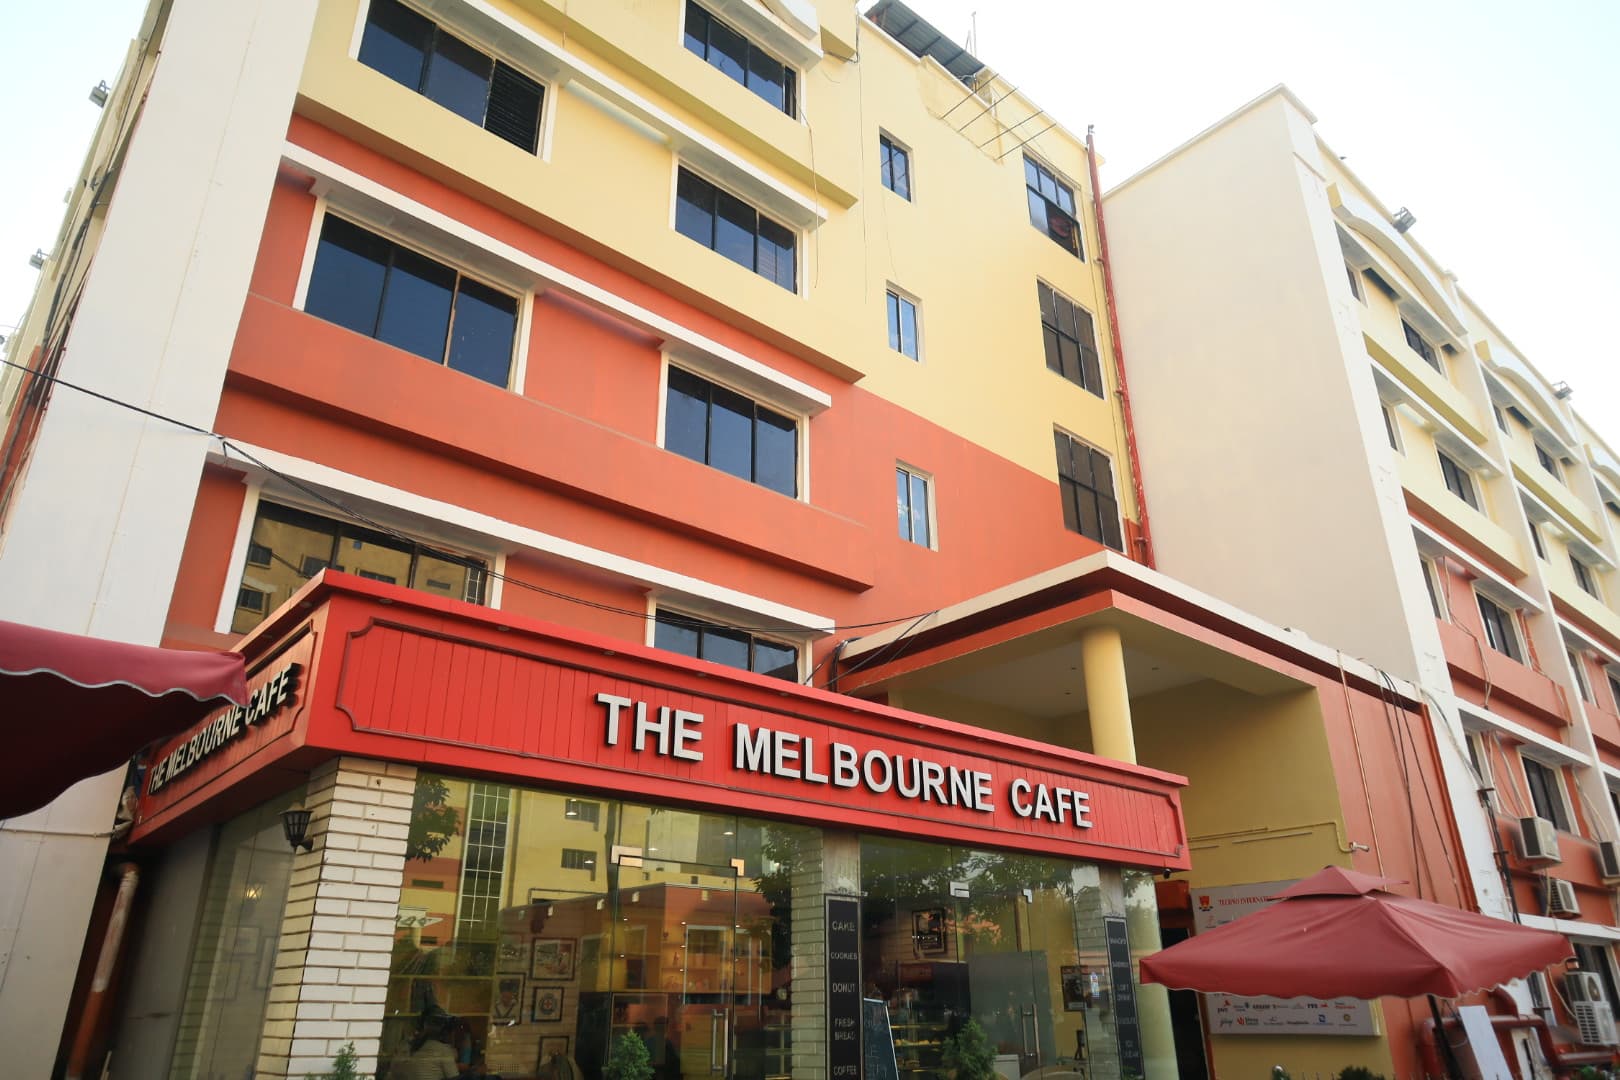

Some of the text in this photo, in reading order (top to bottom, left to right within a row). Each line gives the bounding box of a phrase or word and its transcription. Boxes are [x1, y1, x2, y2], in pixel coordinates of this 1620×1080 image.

[147, 663, 295, 795] THE MELBOURNE CAFE
[596, 692, 1094, 829] THE MELBOURNE CAFE
[831, 920, 856, 932] CAKE
[830, 951, 858, 961] COOKIES
[832, 982, 856, 993] DONUT
[834, 1017, 855, 1028] FRESH
[834, 1031, 856, 1041] BREAD
[833, 1065, 857, 1077] COFFEE
